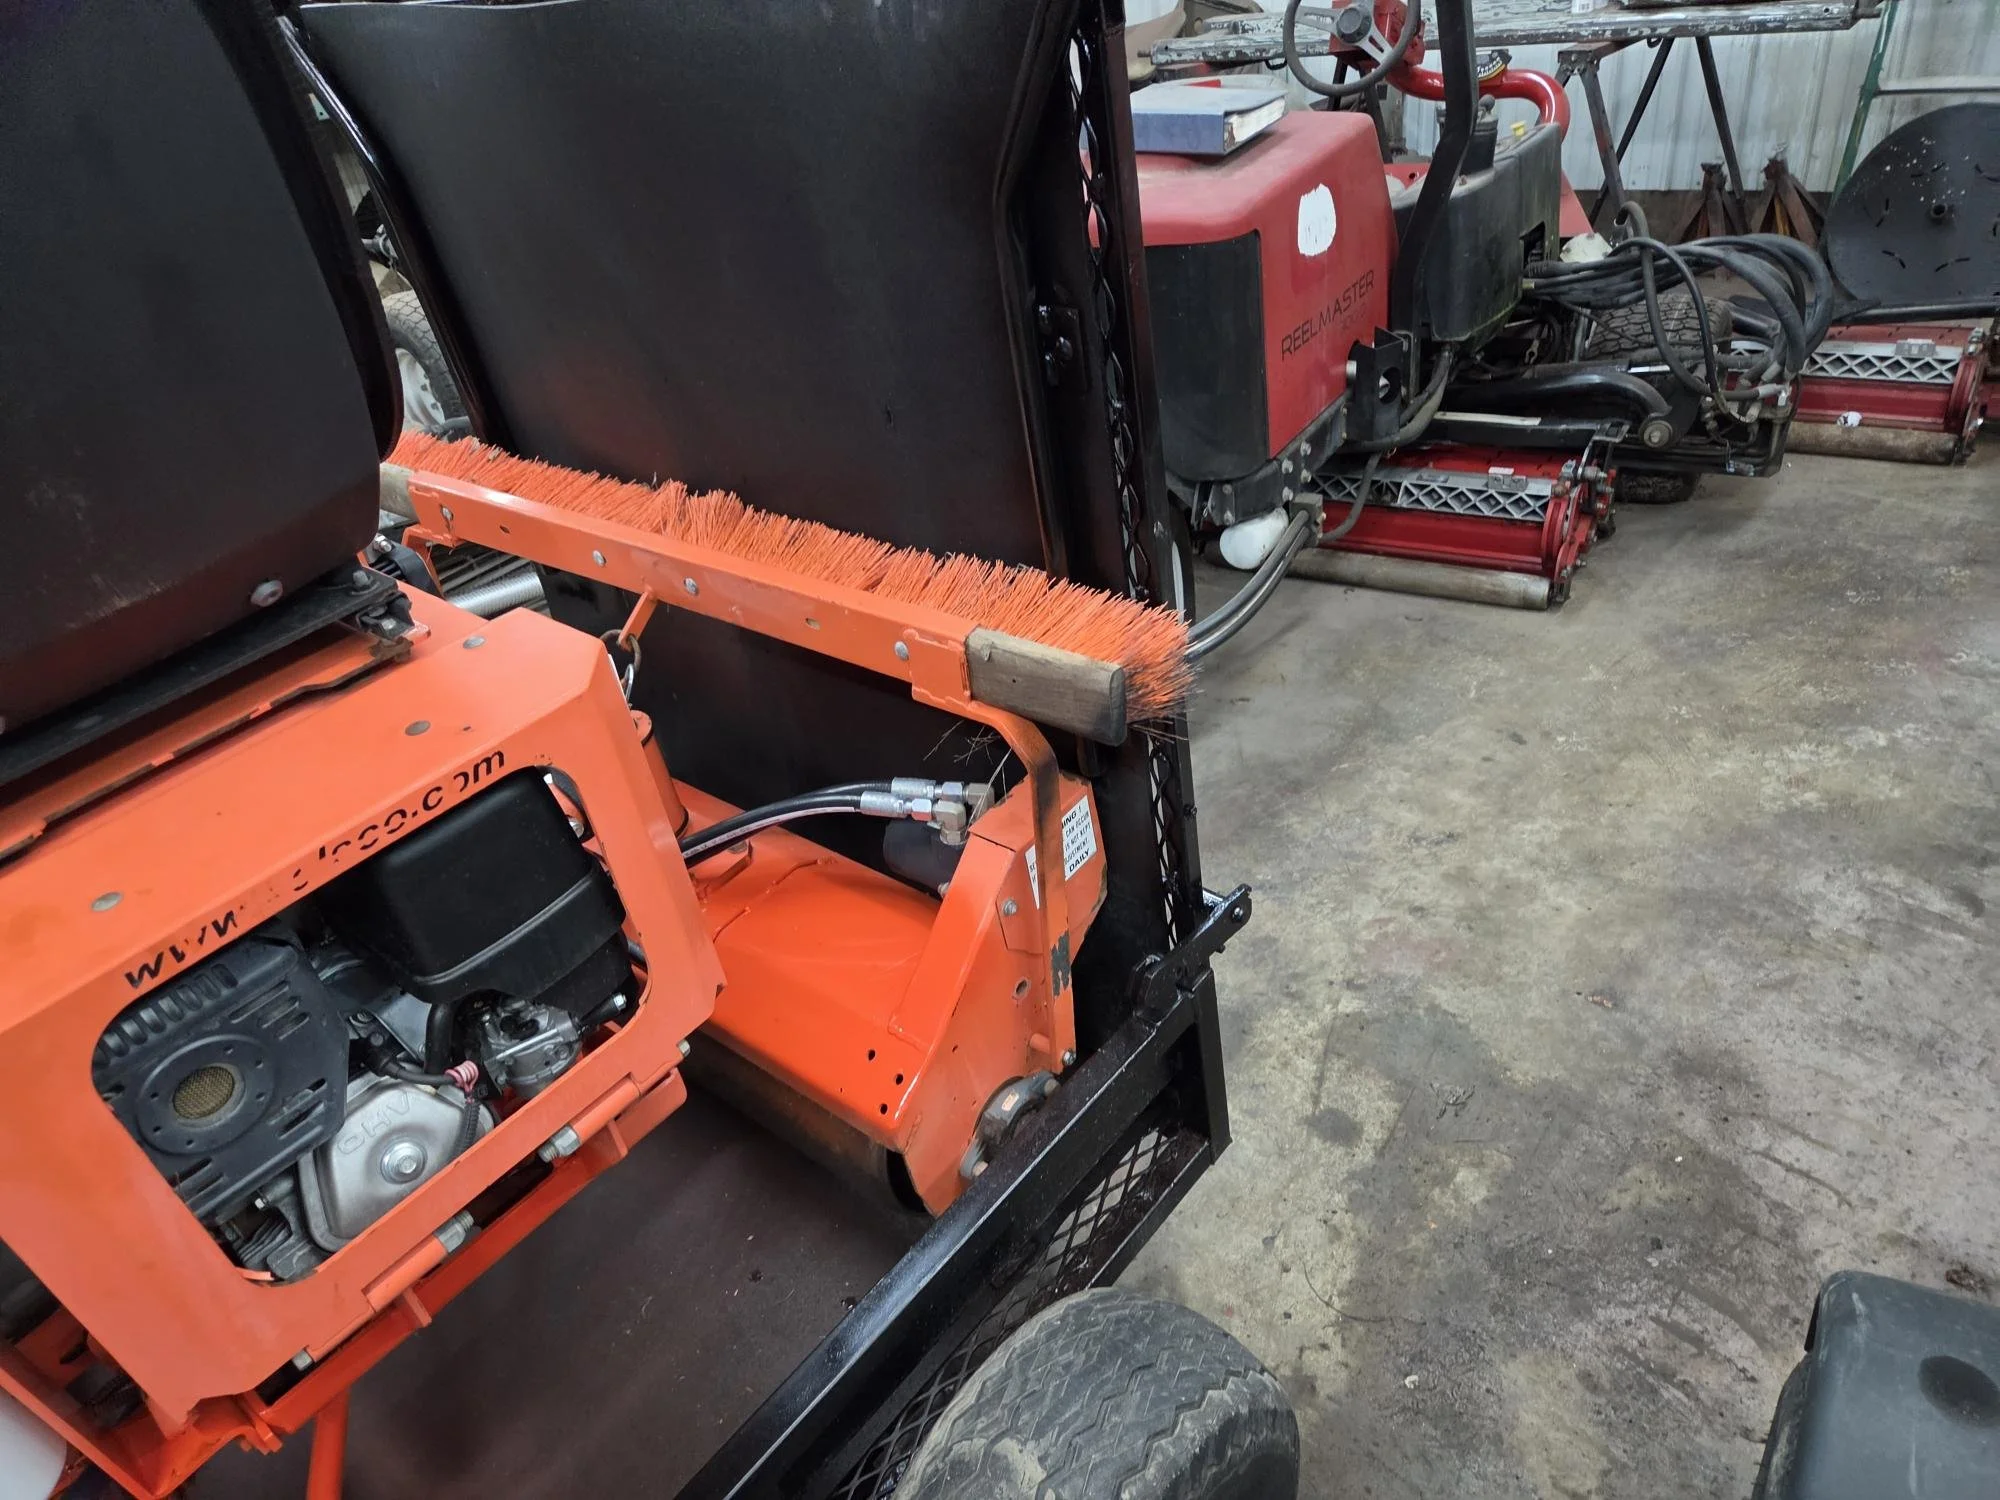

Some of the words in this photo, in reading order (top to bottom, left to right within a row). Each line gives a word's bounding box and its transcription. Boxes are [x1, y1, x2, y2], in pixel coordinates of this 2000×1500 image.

[1281, 269, 1374, 361] REELMASTER
[1069, 848, 1090, 873] DAILY
[337, 1089, 411, 1155] OHV
